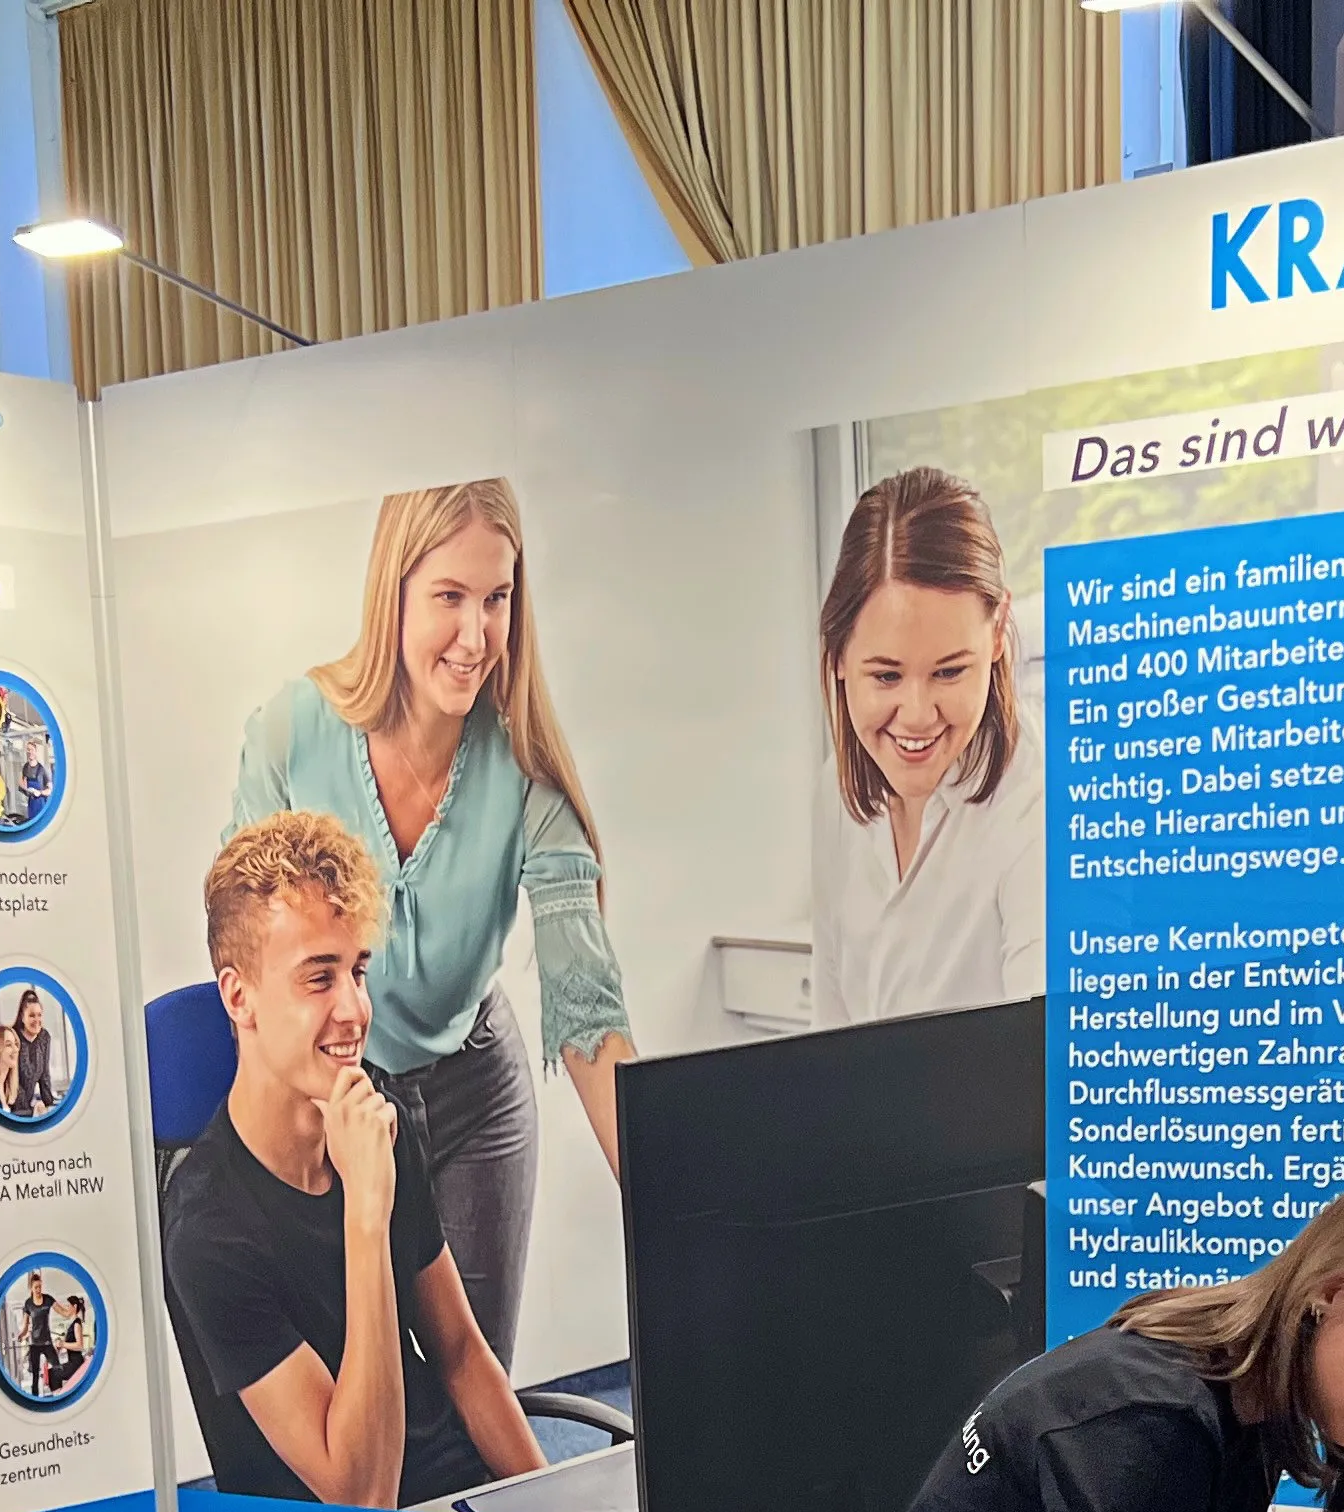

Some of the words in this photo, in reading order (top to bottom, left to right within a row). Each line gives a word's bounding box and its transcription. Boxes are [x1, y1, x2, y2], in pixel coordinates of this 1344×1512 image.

[1070, 436, 1160, 483] Das
[1179, 405, 1288, 469] sind
[1067, 580, 1112, 608] Wir
[1121, 569, 1176, 602] sind
[1185, 562, 1226, 595] ein
[1067, 656, 1127, 687] rund
[1137, 649, 1188, 679] 400
[1068, 699, 1108, 726] Ein
[1117, 685, 1208, 729] großer
[1068, 735, 1106, 764] für
[1113, 733, 1202, 762] unsere
[1068, 771, 1173, 805] wichtig.
[1181, 764, 1262, 796] Dabei
[1068, 810, 1147, 842] flache
[1155, 800, 1310, 837] Hierarchien
[1068, 930, 1159, 956] Unsere
[1068, 967, 1148, 1000] liegen
[1157, 965, 1180, 992] in
[1189, 962, 1233, 990] der
[1068, 1005, 1219, 1036] Herstellung
[1229, 999, 1281, 1028] und
[1290, 998, 1323, 1026] im
[1068, 1040, 1249, 1073] hochwertigen
[1068, 1116, 1281, 1149] Sonderlösungen
[58, 1151, 93, 1172] nach
[1068, 1155, 1274, 1183] Kundenwunsch.
[16, 1179, 63, 1200] Metall
[66, 1176, 105, 1196] NRW
[1068, 1195, 1138, 1218] unser
[1146, 1193, 1264, 1224] Angebot
[1069, 1264, 1116, 1289] und
[0, 1461, 61, 1486] zentrum
